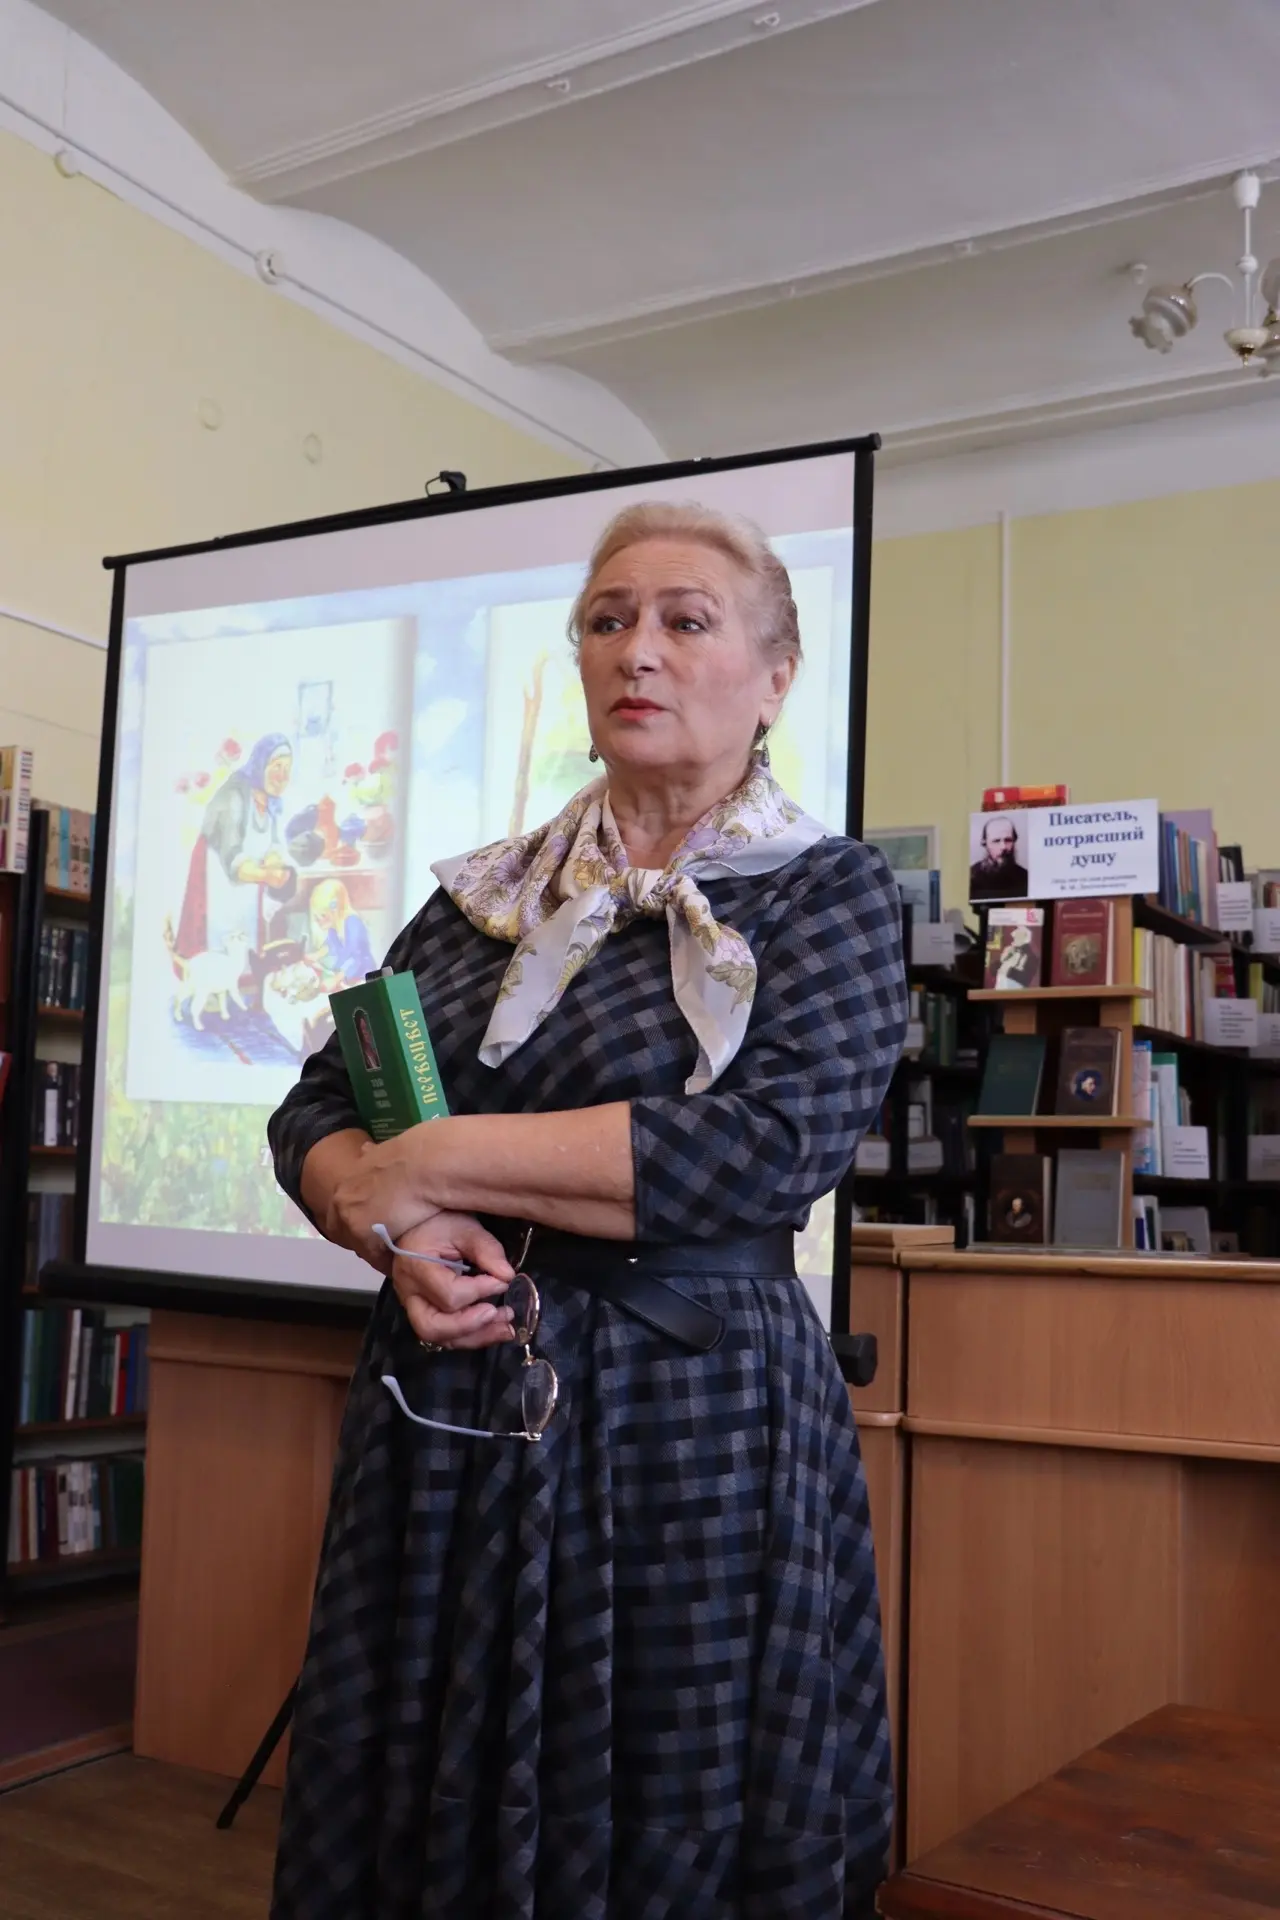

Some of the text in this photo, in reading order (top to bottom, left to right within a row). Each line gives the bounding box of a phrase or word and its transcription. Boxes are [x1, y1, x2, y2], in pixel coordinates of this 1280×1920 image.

[1048, 810, 1139, 827] Писатель,
[1043, 826, 1145, 848] потрясший
[1070, 852, 1117, 868] душу
